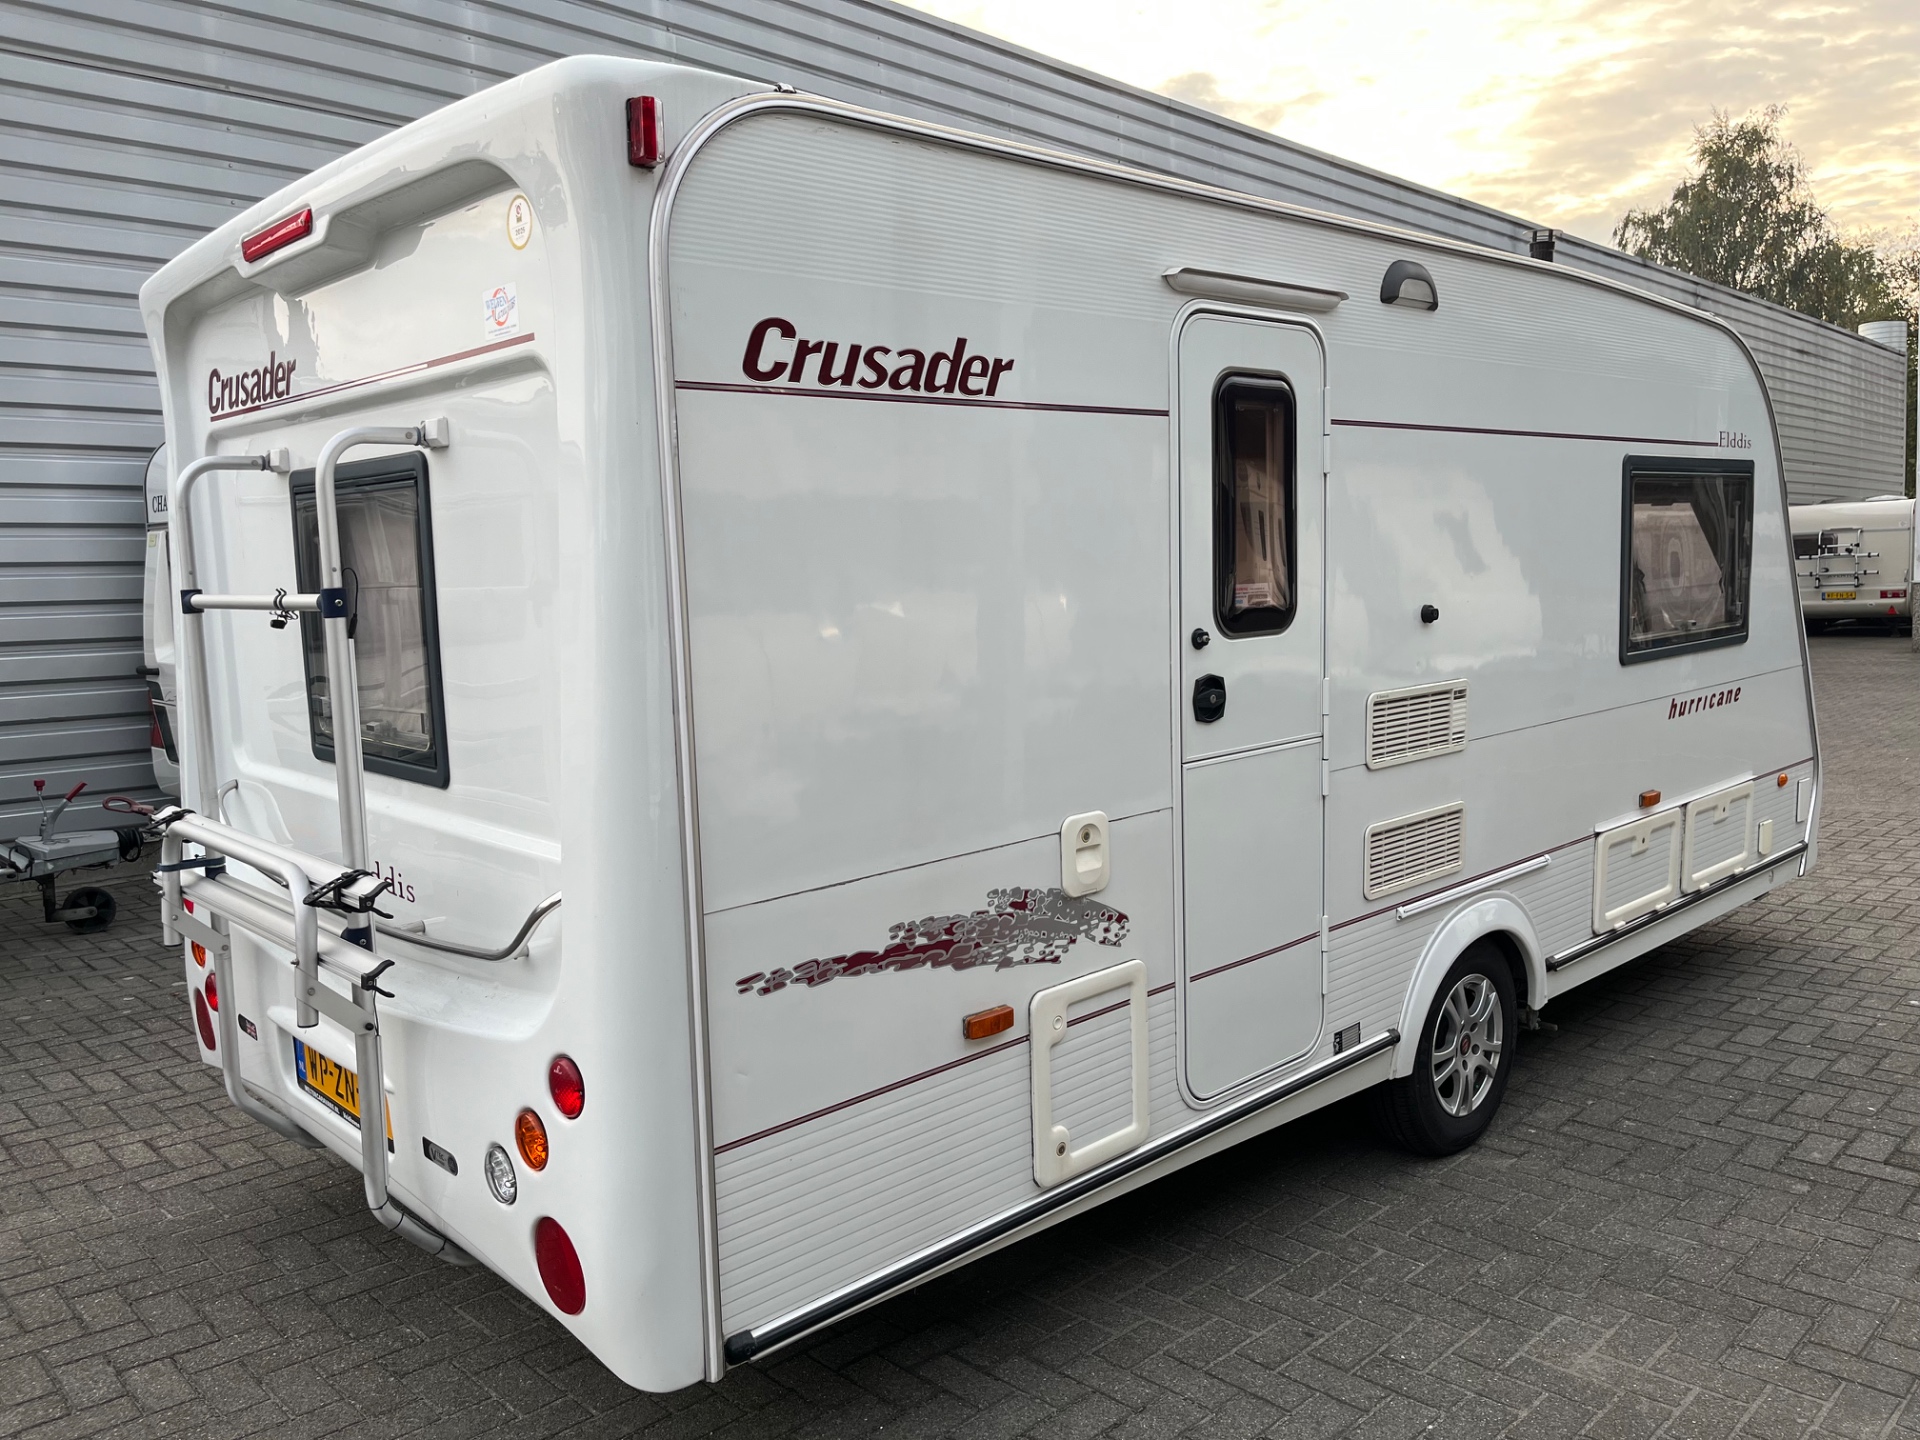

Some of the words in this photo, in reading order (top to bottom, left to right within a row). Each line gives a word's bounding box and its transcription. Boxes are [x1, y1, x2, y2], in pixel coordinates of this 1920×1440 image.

[742, 317, 1015, 397] Crusader
[209, 350, 296, 414] Crusader
[1719, 431, 1752, 449] Elddis
[1668, 686, 1742, 720] hurricane
